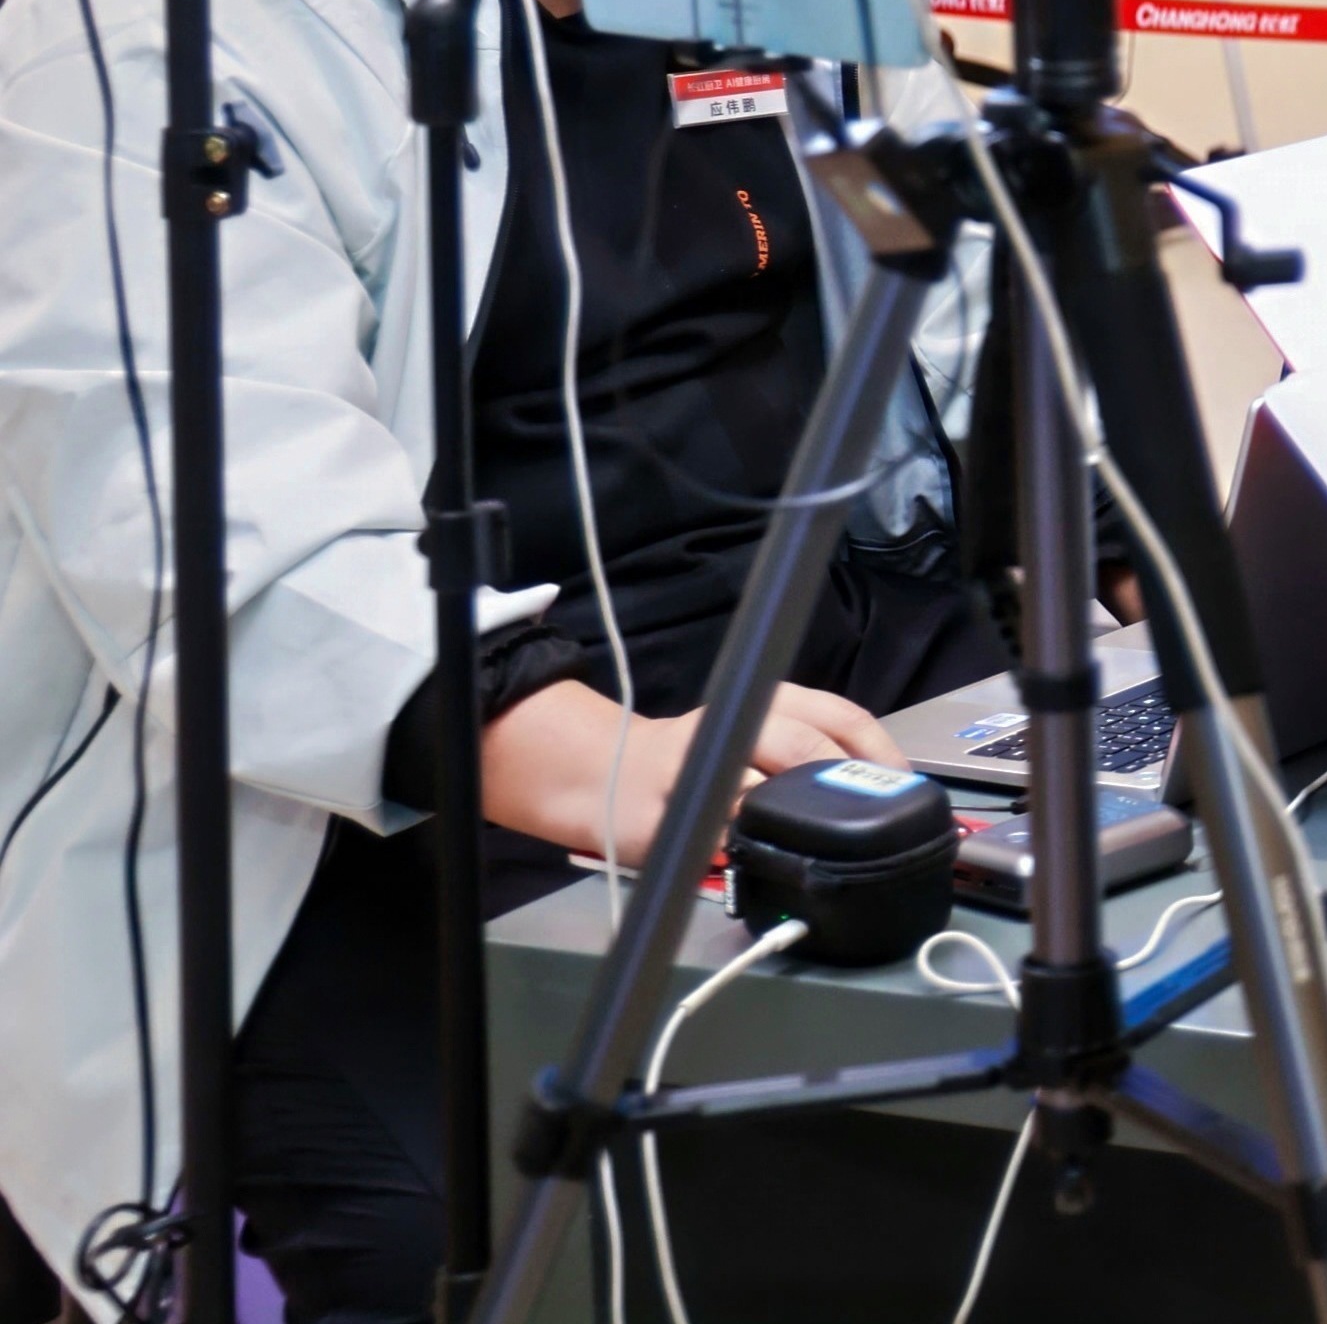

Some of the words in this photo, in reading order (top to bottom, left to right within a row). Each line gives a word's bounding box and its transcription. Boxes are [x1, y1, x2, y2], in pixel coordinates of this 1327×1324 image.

[1135, 2, 1258, 32] CHANGHONG
[709, 97, 757, 117] 应伟鹏
